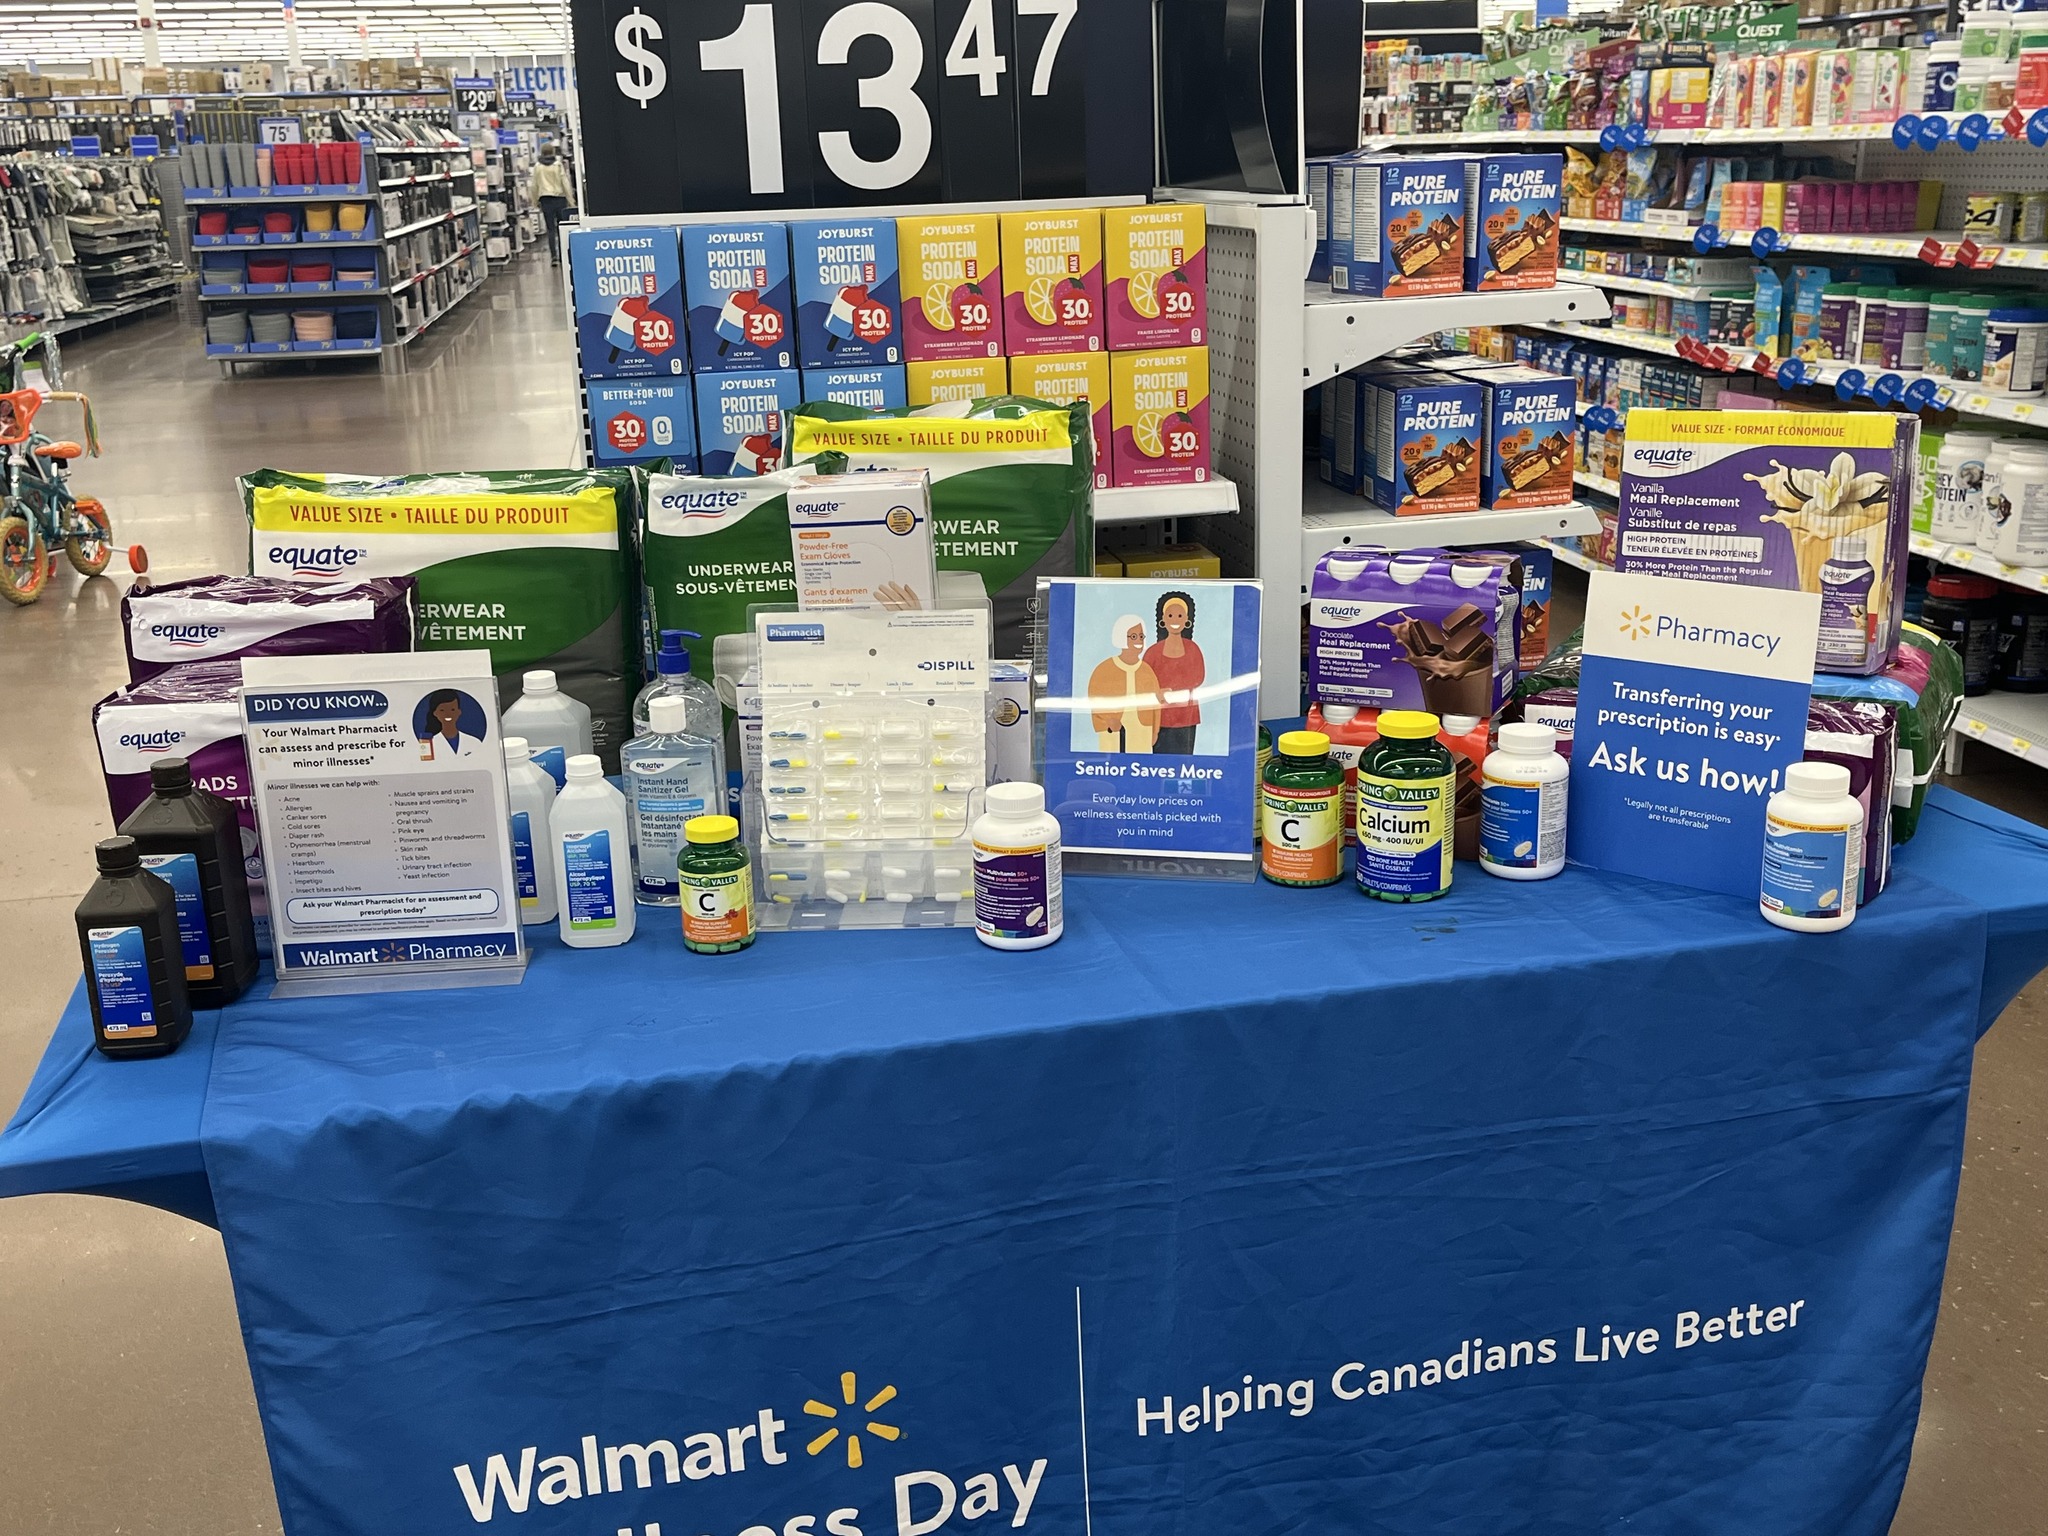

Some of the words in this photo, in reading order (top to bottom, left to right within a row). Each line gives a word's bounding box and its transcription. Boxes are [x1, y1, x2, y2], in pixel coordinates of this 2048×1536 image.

[1737, 24, 1783, 37] QUEST
[1386, 168, 1400, 178] 12
[1502, 170, 1544, 187] PURE
[1403, 174, 1446, 190] PURE
[1390, 189, 1460, 206] PROTEIN
[1489, 184, 1556, 202] PROTEIN
[1024, 219, 1078, 231] JOYBURST
[1129, 213, 1182, 225] JOYBURST
[707, 232, 764, 244] JOYBURST
[817, 228, 874, 239] JOYBURST
[920, 224, 975, 236] JOYBURST
[595, 239, 653, 250] JOYBURST
[921, 241, 977, 260] PROTEIN
[708, 249, 766, 268] PROTEIN
[818, 244, 875, 263] PROTEIN
[1130, 250, 1169, 269] SODA
[596, 256, 655, 274] PROTEIN
[922, 262, 963, 280] SODA
[709, 269, 752, 289] SODA
[756, 269, 765, 286] MAX
[819, 264, 862, 284] SODA
[598, 275, 642, 296] SODA
[1134, 356, 1187, 368] JOYBURST
[720, 379, 776, 391] JOYBURST
[1134, 372, 1188, 391] PROTEIN
[603, 388, 673, 400] BETTER-FOR-YOU
[1515, 394, 1558, 410] PURE
[1417, 401, 1462, 416] PURE
[1502, 408, 1571, 425] PROTEIN
[1404, 414, 1476, 430] PROTEIN
[814, 432, 855, 446] VALUE
[863, 432, 890, 446] SIZE
[910, 431, 954, 445] TAILLE
[961, 431, 980, 445] DU
[987, 429, 1048, 444] PRODUIT
[1672, 424, 1702, 433] VALUE
[1704, 425, 1724, 434] SIZE
[1735, 426, 1774, 435] FORMAT
[1778, 424, 1844, 437] ÉCONOMIQUE
[1634, 448, 1692, 464] equate
[1631, 483, 1664, 493] Vanilla
[662, 491, 739, 513] equate
[796, 502, 839, 514] equate
[1630, 494, 1657, 503] Meal
[1661, 495, 1740, 507] Replacement
[290, 506, 342, 523] VALUE
[348, 507, 383, 523] SIZE
[405, 508, 458, 524] TAILLE
[465, 508, 489, 524] DU
[495, 507, 569, 525] PRODUIT
[1629, 507, 1662, 517] Vanille
[1628, 518, 1681, 529] Substitut
[1685, 520, 1699, 530] de
[1704, 522, 1737, 533] repas
[1650, 536, 1686, 544] PROTEIN
[268, 544, 358, 571] equate
[1627, 545, 1659, 553] TENEUR
[1662, 546, 1693, 555] ÉLEVÉE
[1710, 548, 1758, 558] PROTÉINES
[689, 561, 793, 577] UNDERWEAR
[1321, 606, 1360, 617] equate
[152, 623, 218, 644] equate
[770, 628, 822, 638] Pharmacist
[1320, 631, 1354, 639] Chocolate
[1657, 616, 1781, 657] Pharmacy
[1340, 640, 1390, 649] Replacement
[921, 661, 975, 671] DISPILL
[254, 699, 282, 712] DID
[286, 697, 319, 711] YOU
[1612, 682, 1724, 718] Transferring
[1730, 700, 1772, 721] your
[262, 729, 287, 738] Your
[290, 726, 336, 737] Walmart
[339, 724, 398, 735] Pharmacist
[1598, 710, 1708, 736] prescription
[1714, 722, 1728, 740] is
[120, 729, 180, 749] equate
[259, 746, 277, 754] can
[280, 745, 312, 753] assess
[315, 742, 334, 751] and
[337, 740, 386, 753] prescribe
[389, 739, 406, 748] for
[293, 759, 324, 768] minor
[1075, 761, 1126, 777] Senior
[1131, 764, 1175, 778] Saves
[1180, 766, 1222, 780] More
[1588, 741, 1648, 776] Ask
[1656, 758, 1689, 783] us
[1701, 756, 1779, 798] how!
[638, 786, 672, 794] Sanitizer
[1399, 789, 1438, 799] VALLEY
[1092, 794, 1136, 806] Everyday
[1138, 796, 1156, 805] low
[1158, 796, 1187, 806] prices
[1190, 798, 1203, 806] on
[1264, 797, 1285, 809] SPRING
[1298, 803, 1327, 811] VALLEY
[1074, 810, 1114, 819] wellness
[1116, 810, 1162, 822] essentials
[1166, 812, 1198, 823] picked
[1200, 813, 1221, 823] with
[1360, 808, 1429, 833] Calcium
[1648, 813, 1661, 821] are
[1662, 815, 1709, 830] transferable
[1655, 805, 1668, 813] not
[1680, 809, 1731, 824] prescriptions
[1117, 828, 1135, 838] you
[1138, 827, 1146, 836] in
[1149, 828, 1173, 837] mind
[1281, 819, 1299, 842] C
[699, 893, 715, 912] C
[300, 948, 379, 965] Walmart
[409, 943, 507, 960] Pharmacy
[1136, 1374, 1314, 1438] Helping
[1331, 1336, 1558, 1400] Canadians
[1574, 1324, 1658, 1364] Live
[1674, 1300, 1805, 1350] Better
[453, 1408, 787, 1523] Walmart
[894, 1459, 1048, 1536] Day
